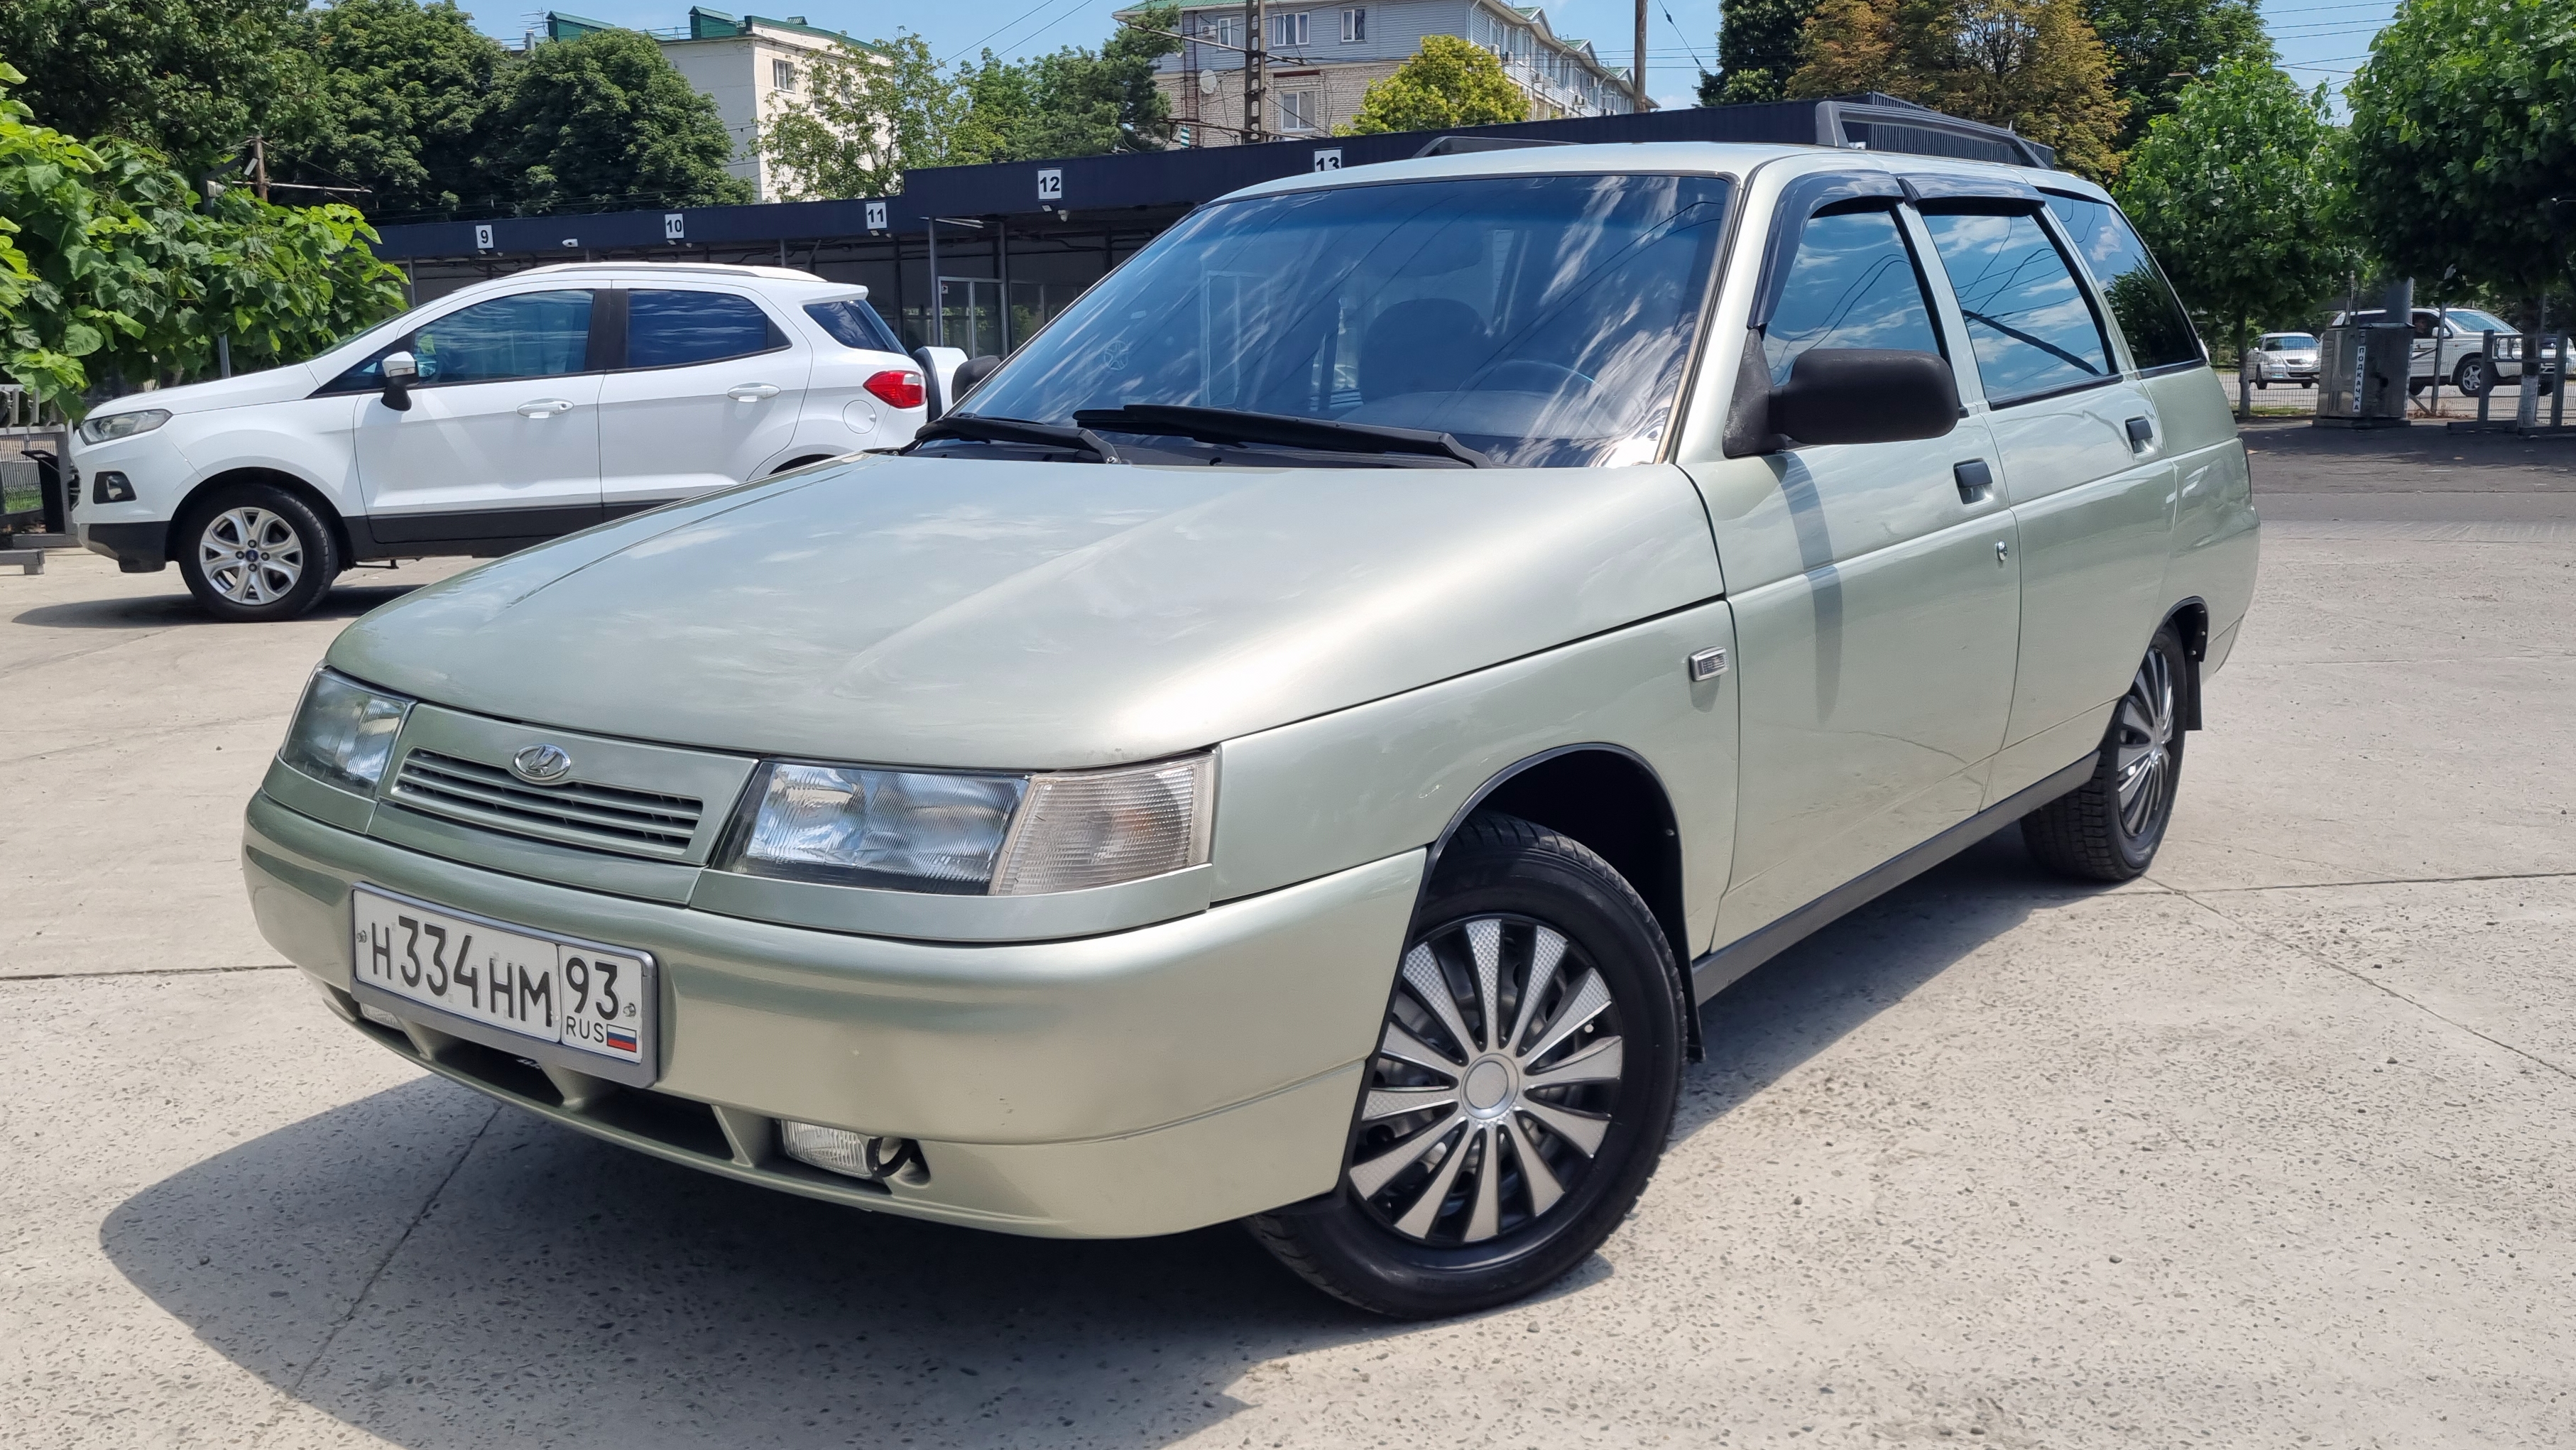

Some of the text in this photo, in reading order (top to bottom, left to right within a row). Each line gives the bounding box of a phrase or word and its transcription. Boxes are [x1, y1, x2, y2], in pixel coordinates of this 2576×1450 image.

[1039, 176, 1060, 192] 12
[868, 208, 884, 223] 11
[667, 219, 682, 233] 10
[481, 229, 489, 244] 9
[2354, 347, 2364, 410] ПОДКАЧКА
[565, 956, 619, 1020] 93
[565, 1015, 605, 1043] RUS
